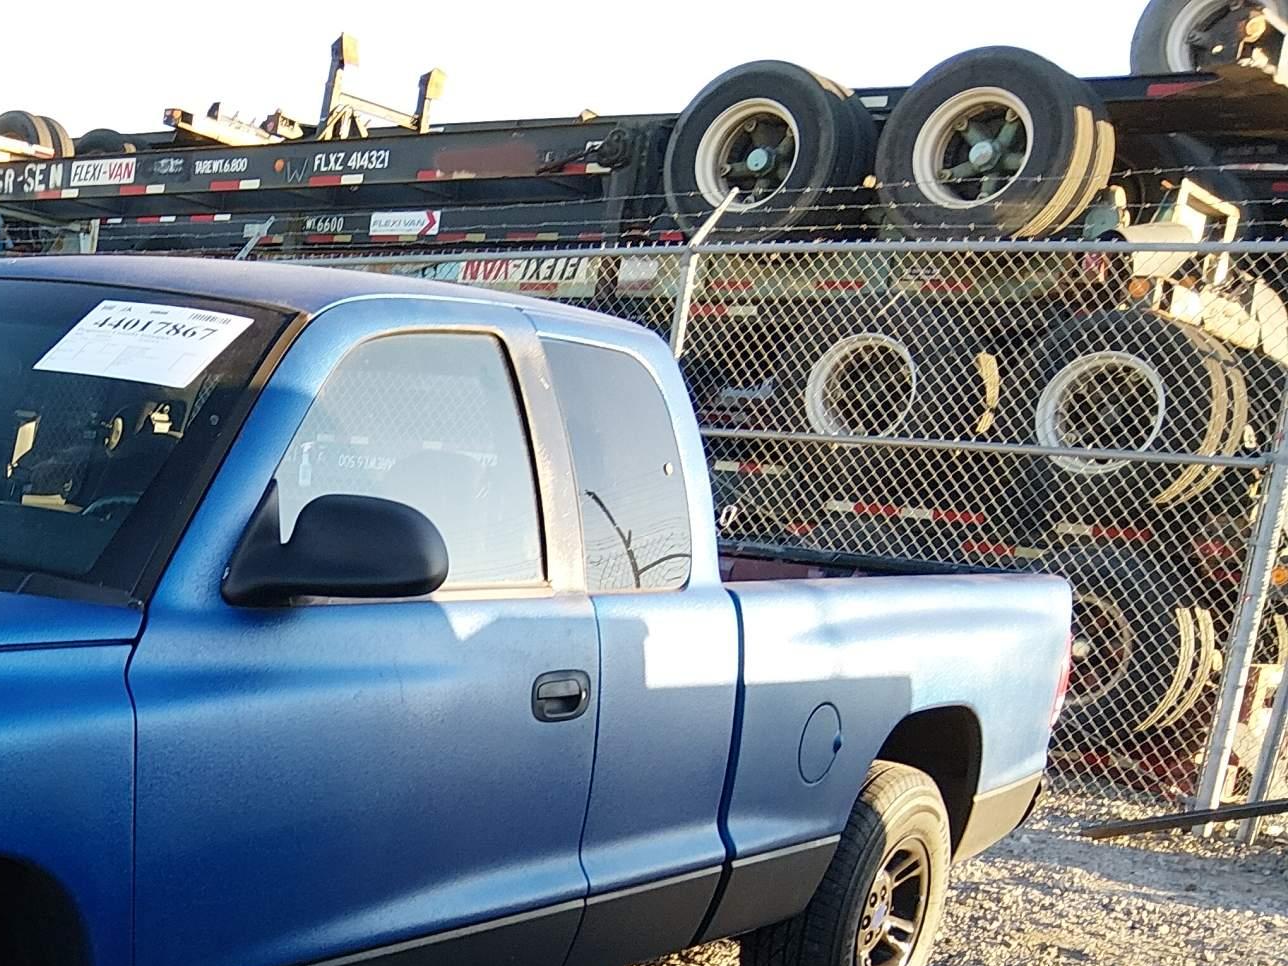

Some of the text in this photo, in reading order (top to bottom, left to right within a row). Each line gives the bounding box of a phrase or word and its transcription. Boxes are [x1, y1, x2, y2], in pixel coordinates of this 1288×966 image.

[72, 160, 134, 183] FLEXI-VAN
[313, 149, 390, 172] FLXZ 414321
[93, 315, 219, 341] 44017867
